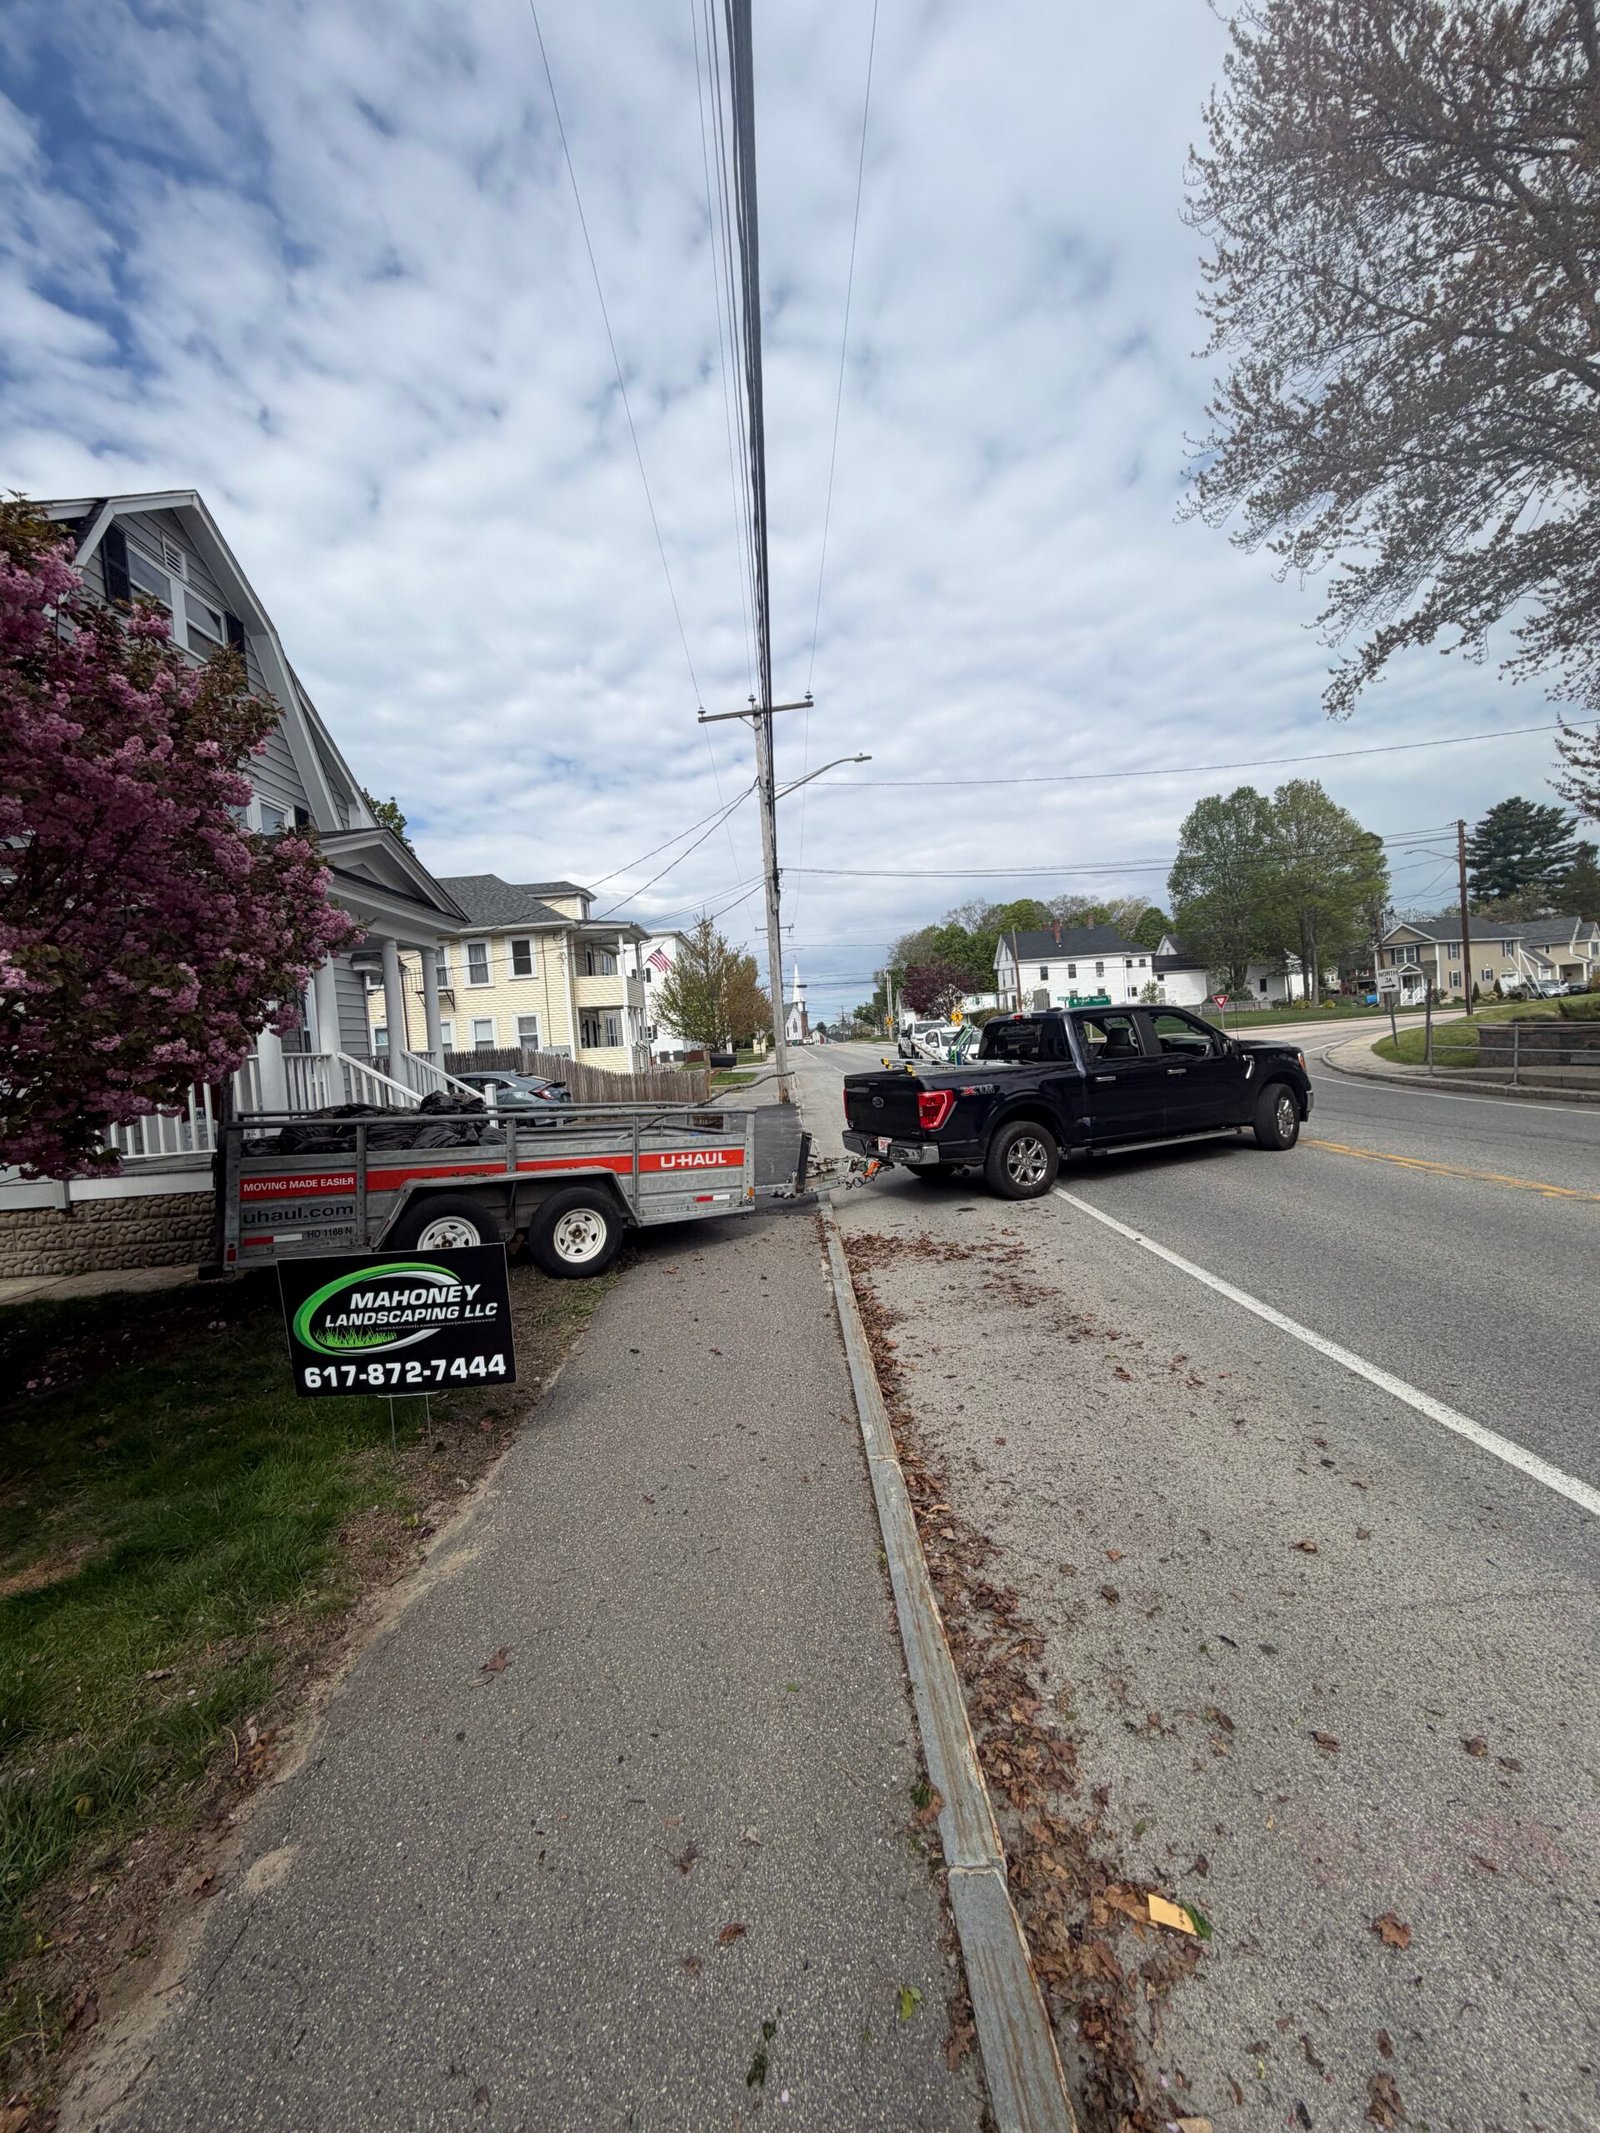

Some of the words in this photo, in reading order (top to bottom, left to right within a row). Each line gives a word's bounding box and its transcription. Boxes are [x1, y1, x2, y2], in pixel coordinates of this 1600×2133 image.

[660, 1152, 727, 1168] U-HAUL
[243, 1182, 287, 1192] MOVING
[289, 1179, 319, 1189] MADE
[320, 1177, 354, 1187] EASIER
[243, 1205, 354, 1224] uhaul.com
[345, 1226, 352, 1235] N
[350, 1284, 481, 1309] MAHONEY
[325, 1306, 459, 1328] LANDSCAPING
[464, 1302, 498, 1318] LLC
[304, 1353, 506, 1388] 617-872-7444
